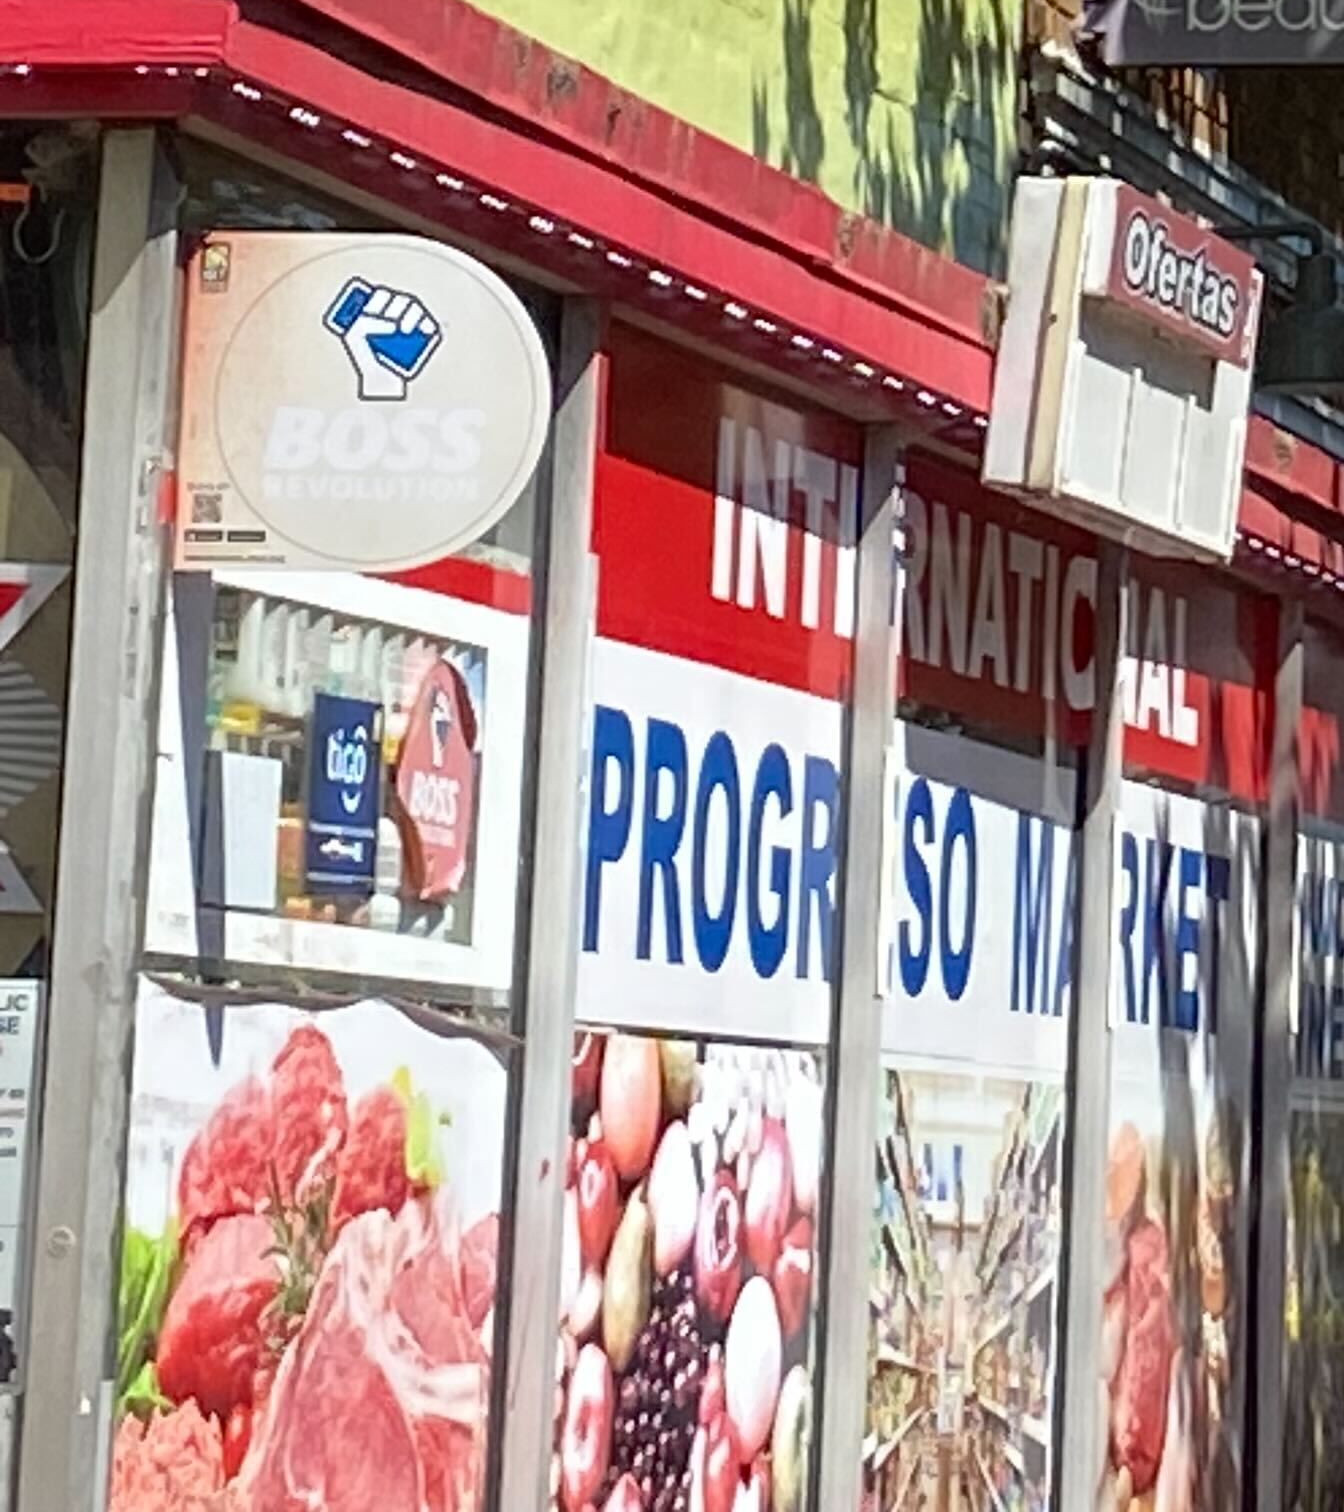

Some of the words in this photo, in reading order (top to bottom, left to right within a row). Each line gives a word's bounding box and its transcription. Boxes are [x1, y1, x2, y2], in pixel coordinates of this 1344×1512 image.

[1123, 210, 1239, 339] Ofertas
[263, 473, 481, 502] REVOLUTION
[264, 407, 485, 473] BOSS
[582, 704, 977, 1000] PROGRSO
